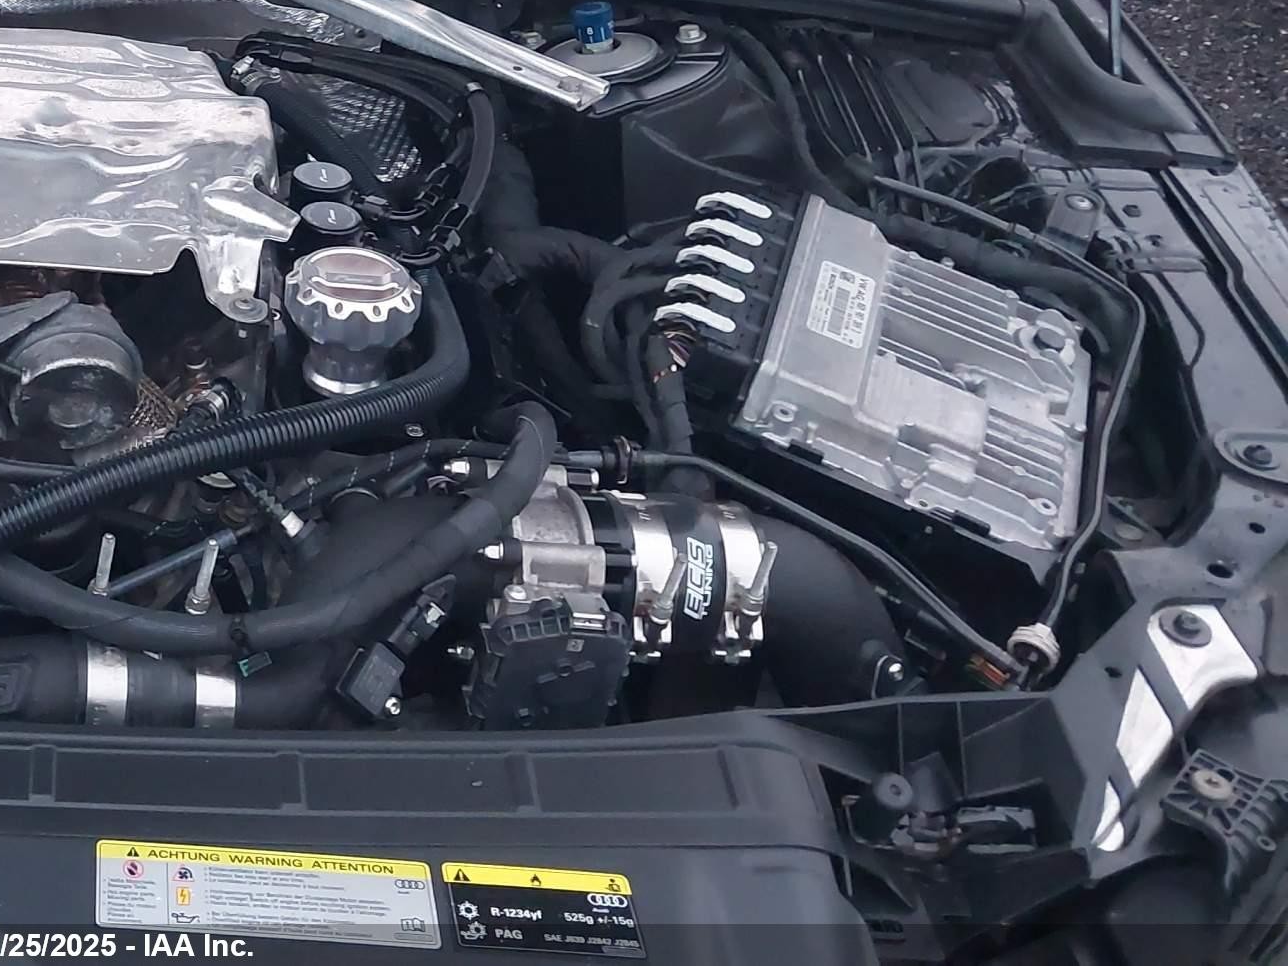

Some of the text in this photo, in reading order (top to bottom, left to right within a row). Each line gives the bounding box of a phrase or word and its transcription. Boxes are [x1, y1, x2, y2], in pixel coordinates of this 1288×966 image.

[683, 536, 707, 620] ECS
[701, 544, 713, 617] TUNING
[147, 849, 394, 874] ACHTUNG WARNING ATTENTION
[490, 906, 543, 921] R-1234yf
[564, 912, 635, 928] 525g +/-15g
[495, 929, 523, 940] PAG
